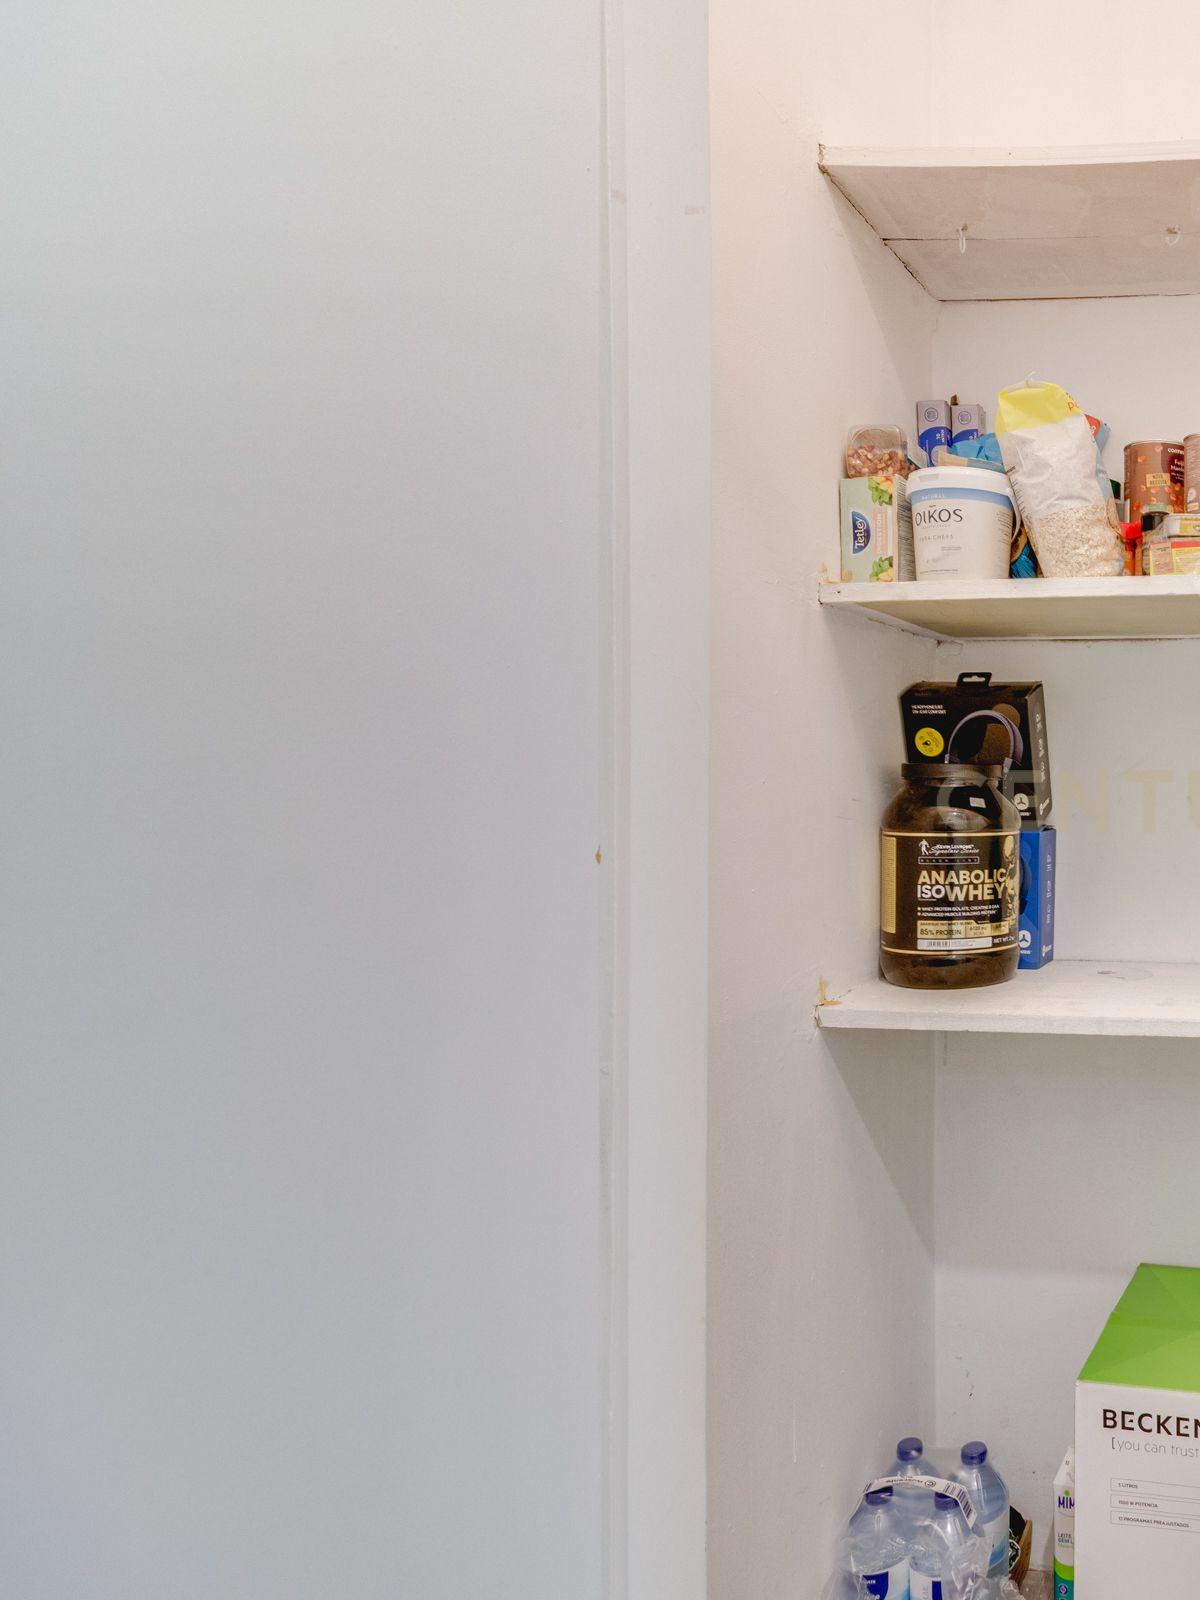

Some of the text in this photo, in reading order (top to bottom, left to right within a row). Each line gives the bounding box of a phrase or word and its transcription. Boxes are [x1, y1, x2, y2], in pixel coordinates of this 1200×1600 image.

[915, 508, 963, 526] OIKOS
[855, 517, 867, 549] Tetley
[917, 868, 1006, 885] ANABOLIC
[936, 928, 961, 936] PROTEIN
[1144, 1442, 1166, 1454] can
